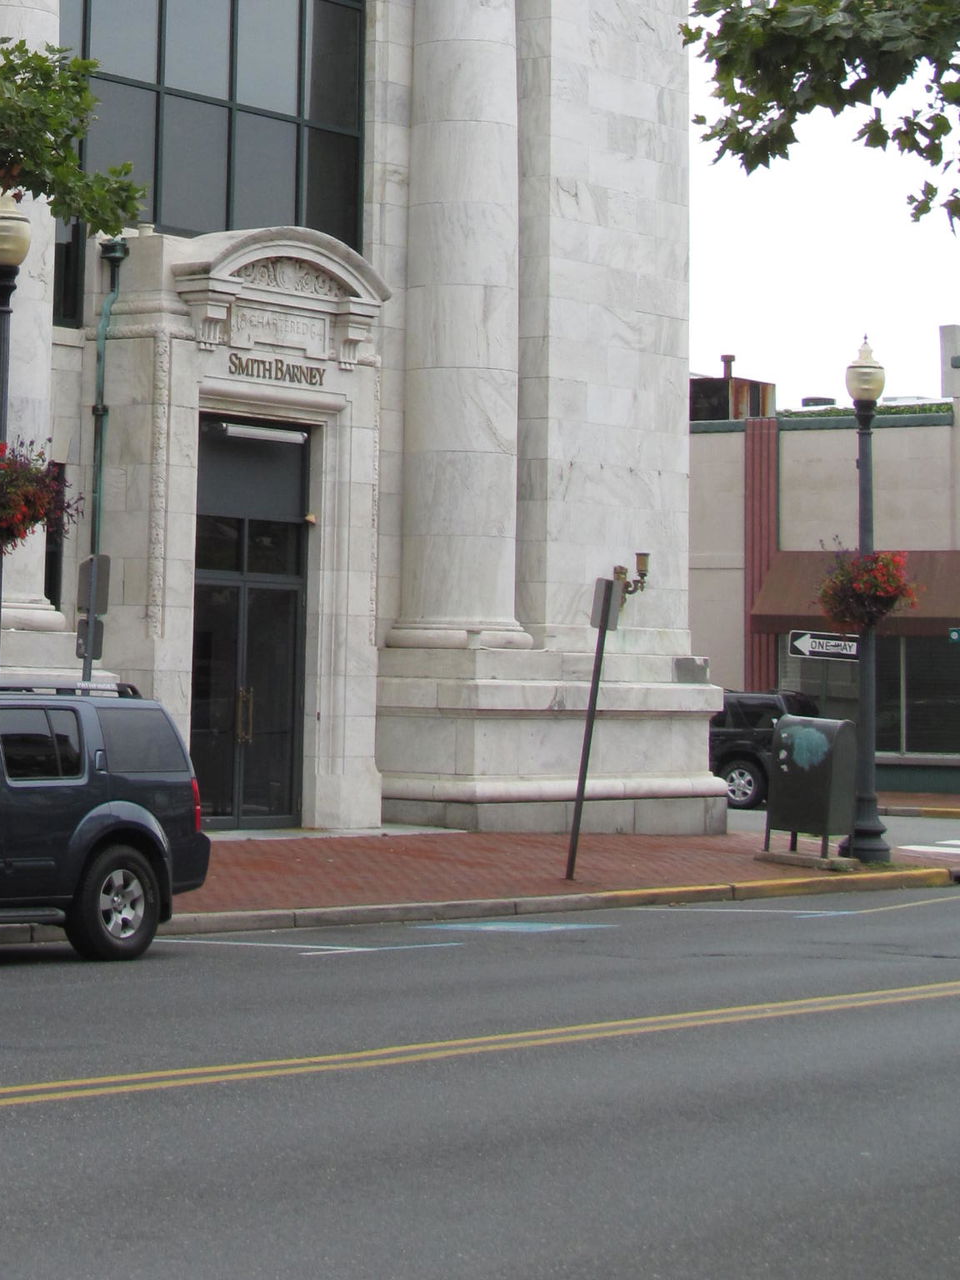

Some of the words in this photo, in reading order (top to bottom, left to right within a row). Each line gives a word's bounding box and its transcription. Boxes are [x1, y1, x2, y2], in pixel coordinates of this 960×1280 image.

[229, 353, 273, 379] SMITH
[274, 359, 326, 386] BARNEY
[810, 640, 830, 651] ONE
